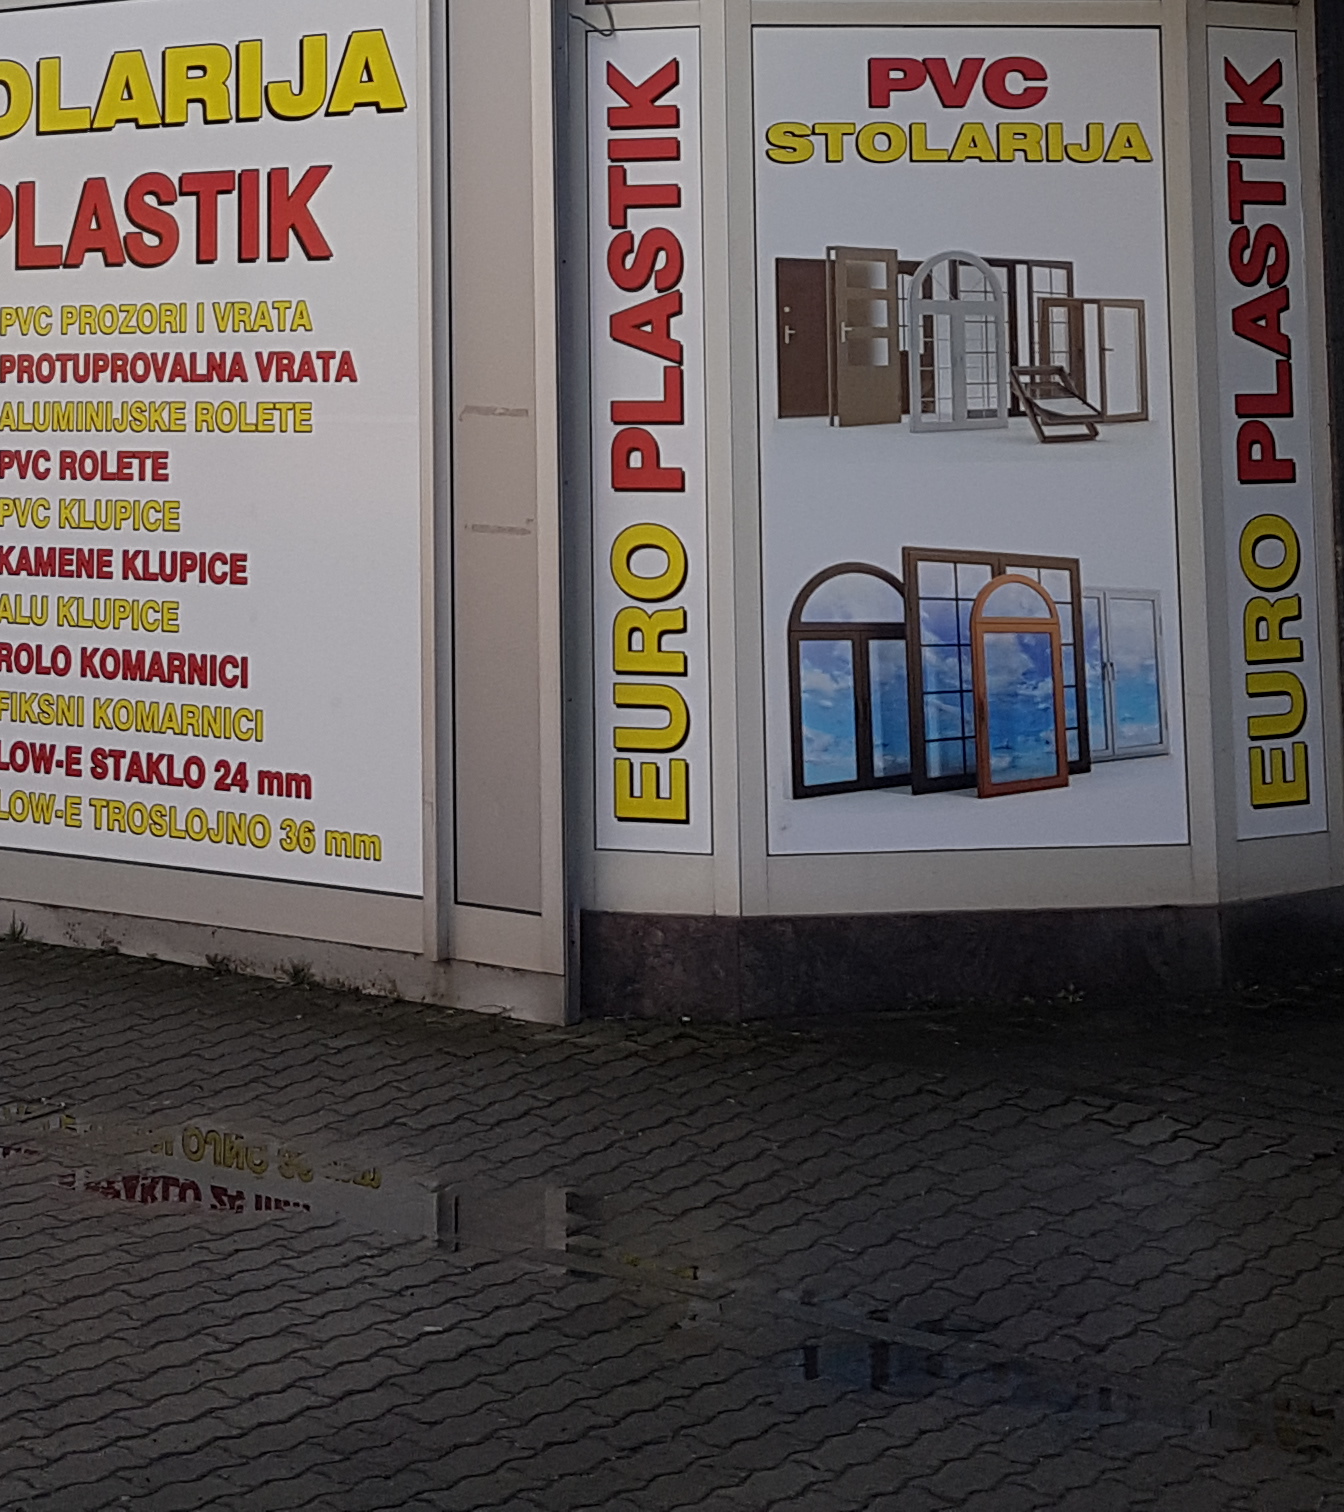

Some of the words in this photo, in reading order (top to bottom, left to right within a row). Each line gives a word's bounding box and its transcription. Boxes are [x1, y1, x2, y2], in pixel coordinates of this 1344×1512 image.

[867, 56, 1050, 110] PVC
[765, 121, 1154, 164] STOLARIJA
[606, 56, 687, 493] PLASTIK
[1223, 56, 1298, 485] PLASTIK
[0, 306, 53, 336] PVC
[60, 302, 187, 335] PROZORI
[196, 302, 205, 333] I
[212, 300, 313, 333] VRATA
[0, 351, 248, 384] PROTUPROVALNA
[255, 350, 358, 383] VRATA
[194, 401, 313, 433] ROLETE
[59, 451, 170, 482] ROLETE
[59, 499, 181, 532] KLUPICE
[122, 549, 248, 585] KLUPICE
[57, 596, 180, 632] KLUPICE
[80, 647, 249, 689] KOMARNICI
[609, 521, 690, 825] EURO
[1239, 511, 1311, 808] EURO
[93, 697, 263, 742] KOMARNICI
[90, 747, 206, 789] STAKLO
[214, 759, 249, 793] 24
[257, 768, 312, 800] mm
[89, 798, 272, 849] TROSLOJNO
[279, 817, 316, 854] 36
[325, 828, 382, 862] mm
